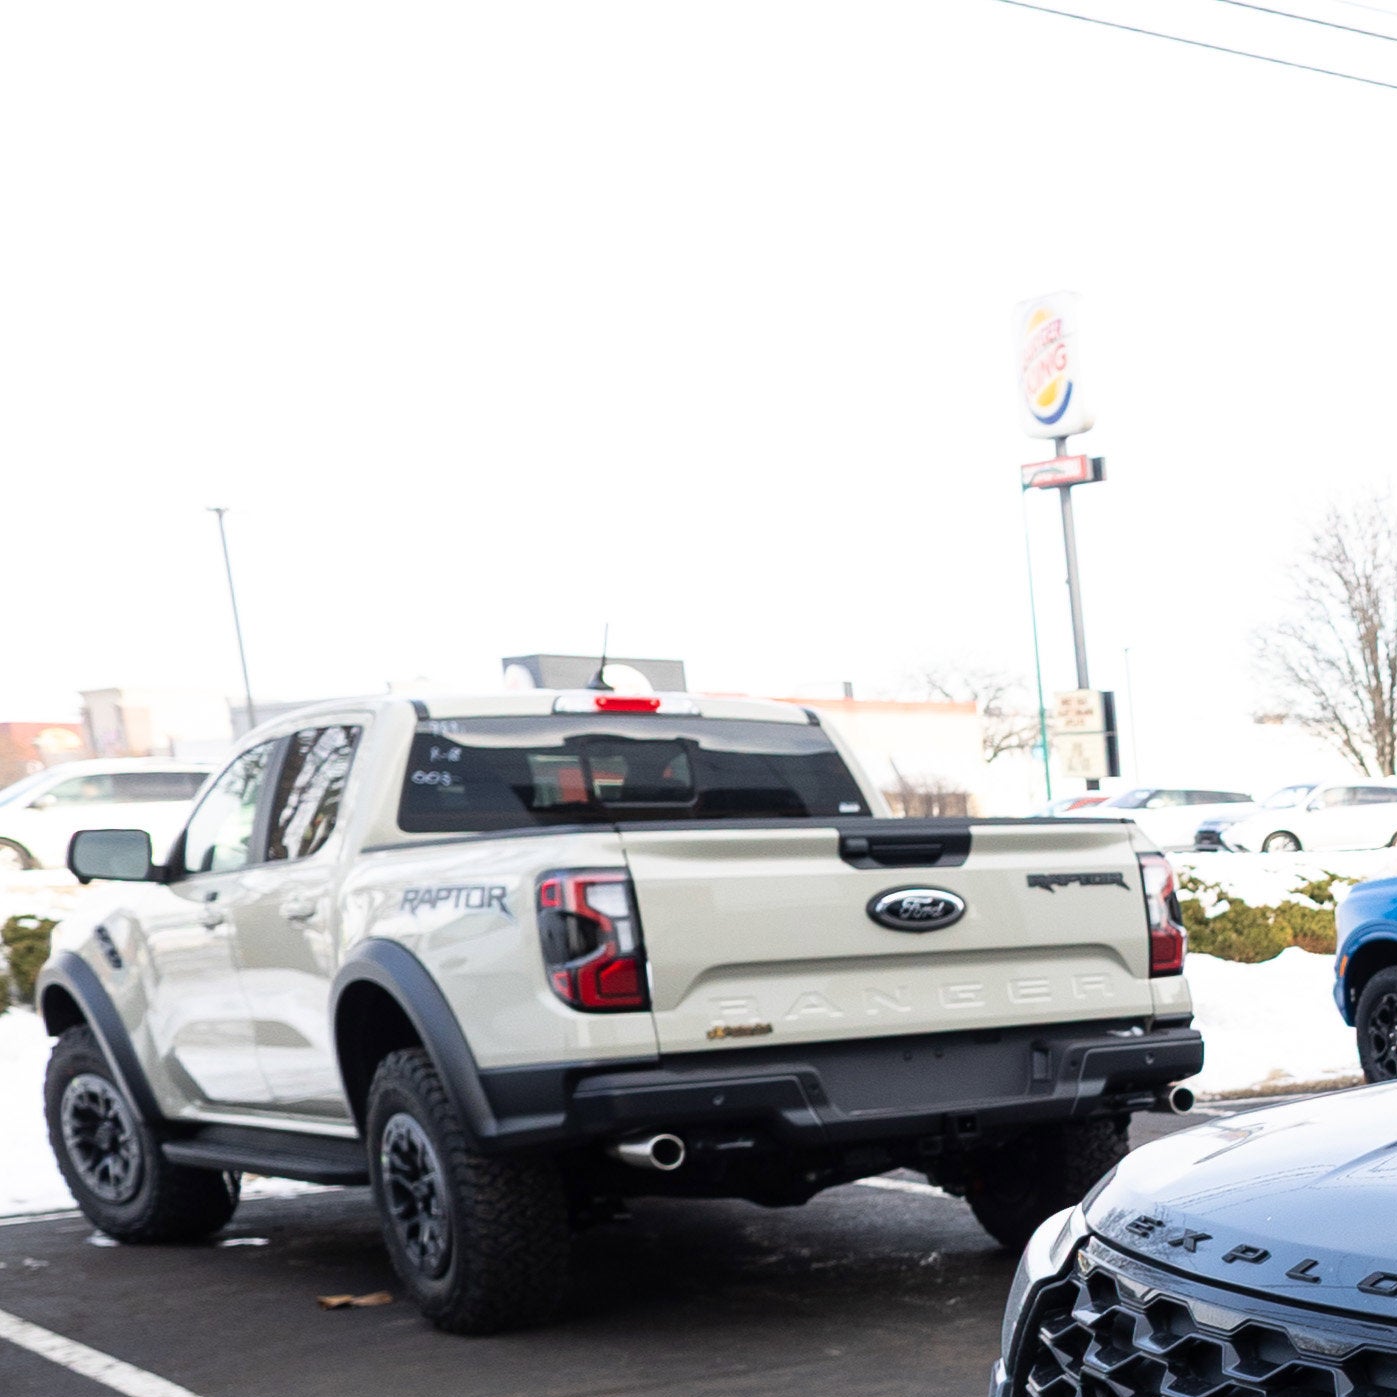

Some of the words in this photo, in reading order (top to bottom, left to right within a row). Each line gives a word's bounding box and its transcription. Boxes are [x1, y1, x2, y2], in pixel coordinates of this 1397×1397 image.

[1026, 871, 1131, 893] RAPTOR
[400, 885, 516, 919] RAPTOR
[707, 972, 1115, 1027] RANGER
